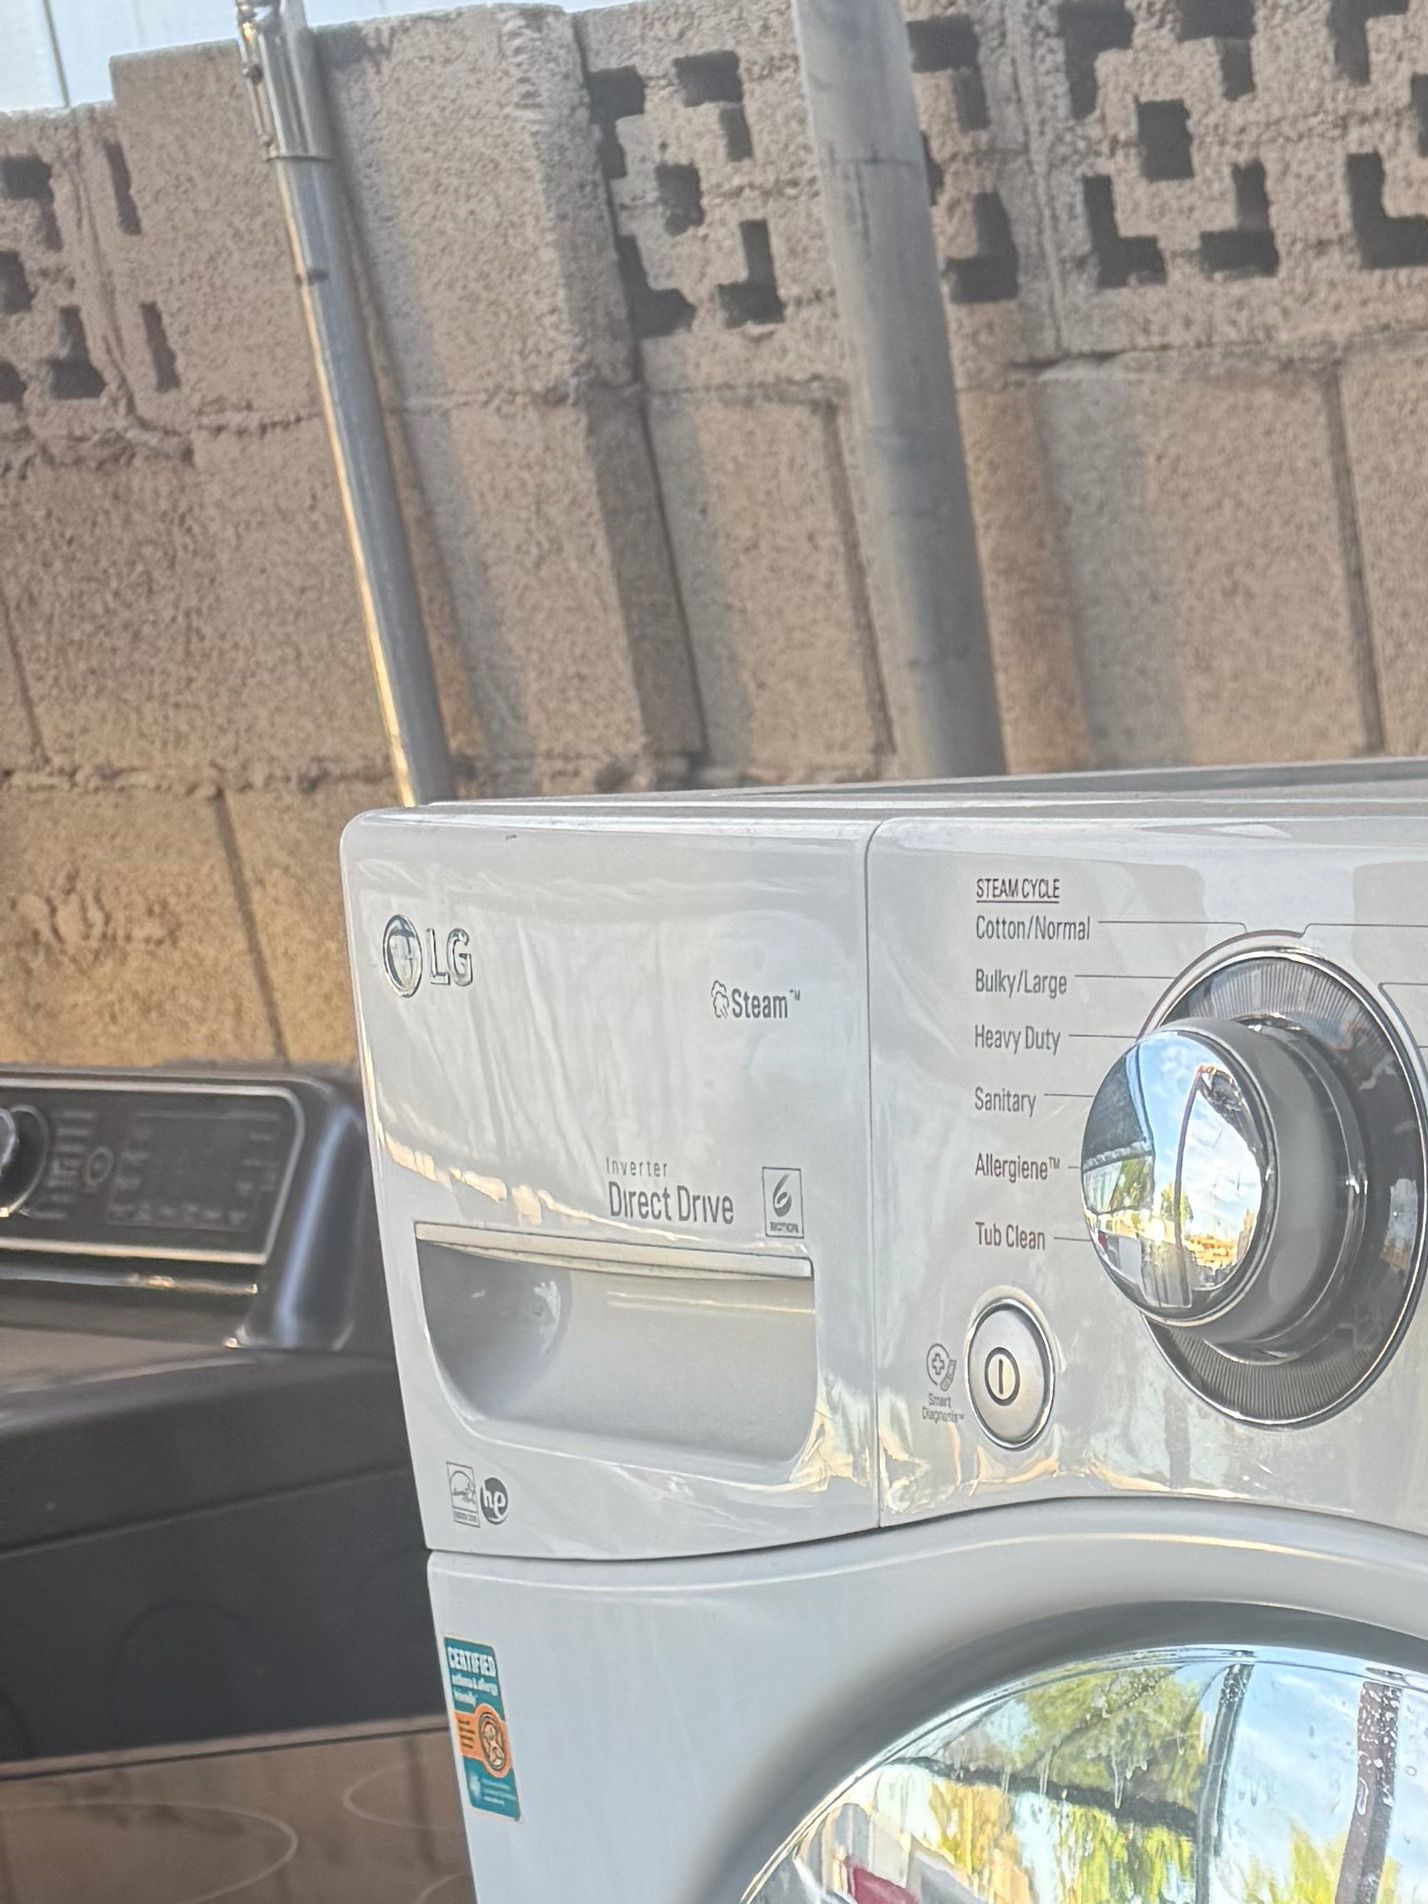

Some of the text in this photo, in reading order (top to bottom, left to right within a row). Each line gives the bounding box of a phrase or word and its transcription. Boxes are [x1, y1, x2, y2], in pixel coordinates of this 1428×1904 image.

[976, 878, 1060, 899] STEAM CYCLE
[976, 915, 1091, 940] Cotton/Normal
[426, 928, 474, 986] LG
[975, 968, 1067, 999] Bulky/Large
[975, 1024, 1061, 1056] Heavy Duty
[975, 1086, 1036, 1118] Sanitary
[605, 1156, 669, 1178] Inverter
[609, 1181, 735, 1225] Direct Drive
[975, 1222, 1046, 1250] Tub Clean
